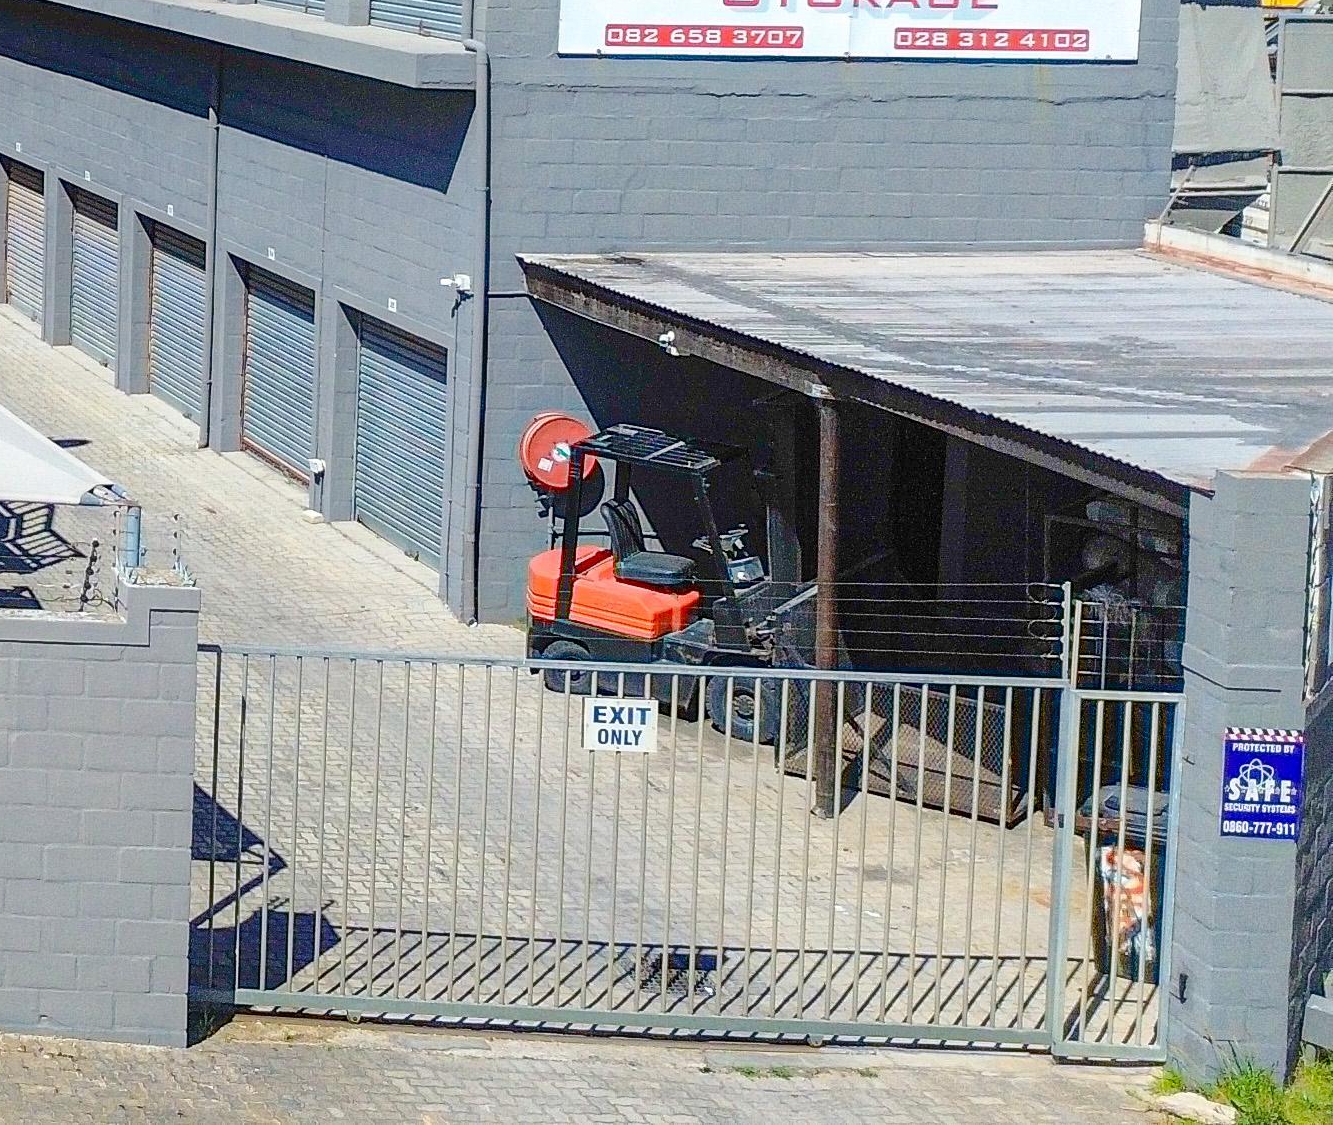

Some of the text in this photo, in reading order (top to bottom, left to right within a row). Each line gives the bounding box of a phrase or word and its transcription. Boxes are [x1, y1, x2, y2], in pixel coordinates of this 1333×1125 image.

[607, 28, 803, 45] 082 658 3707
[896, 31, 1087, 48] 028 312 4102
[593, 705, 652, 725] EXIT
[597, 728, 643, 746] ONLY
[1232, 743, 1295, 754] PROTECTED BY
[1228, 778, 1292, 803] SAFE
[1224, 802, 1296, 814] SECURITY SYSTEMS
[1222, 820, 1295, 835] 0860-777-911
